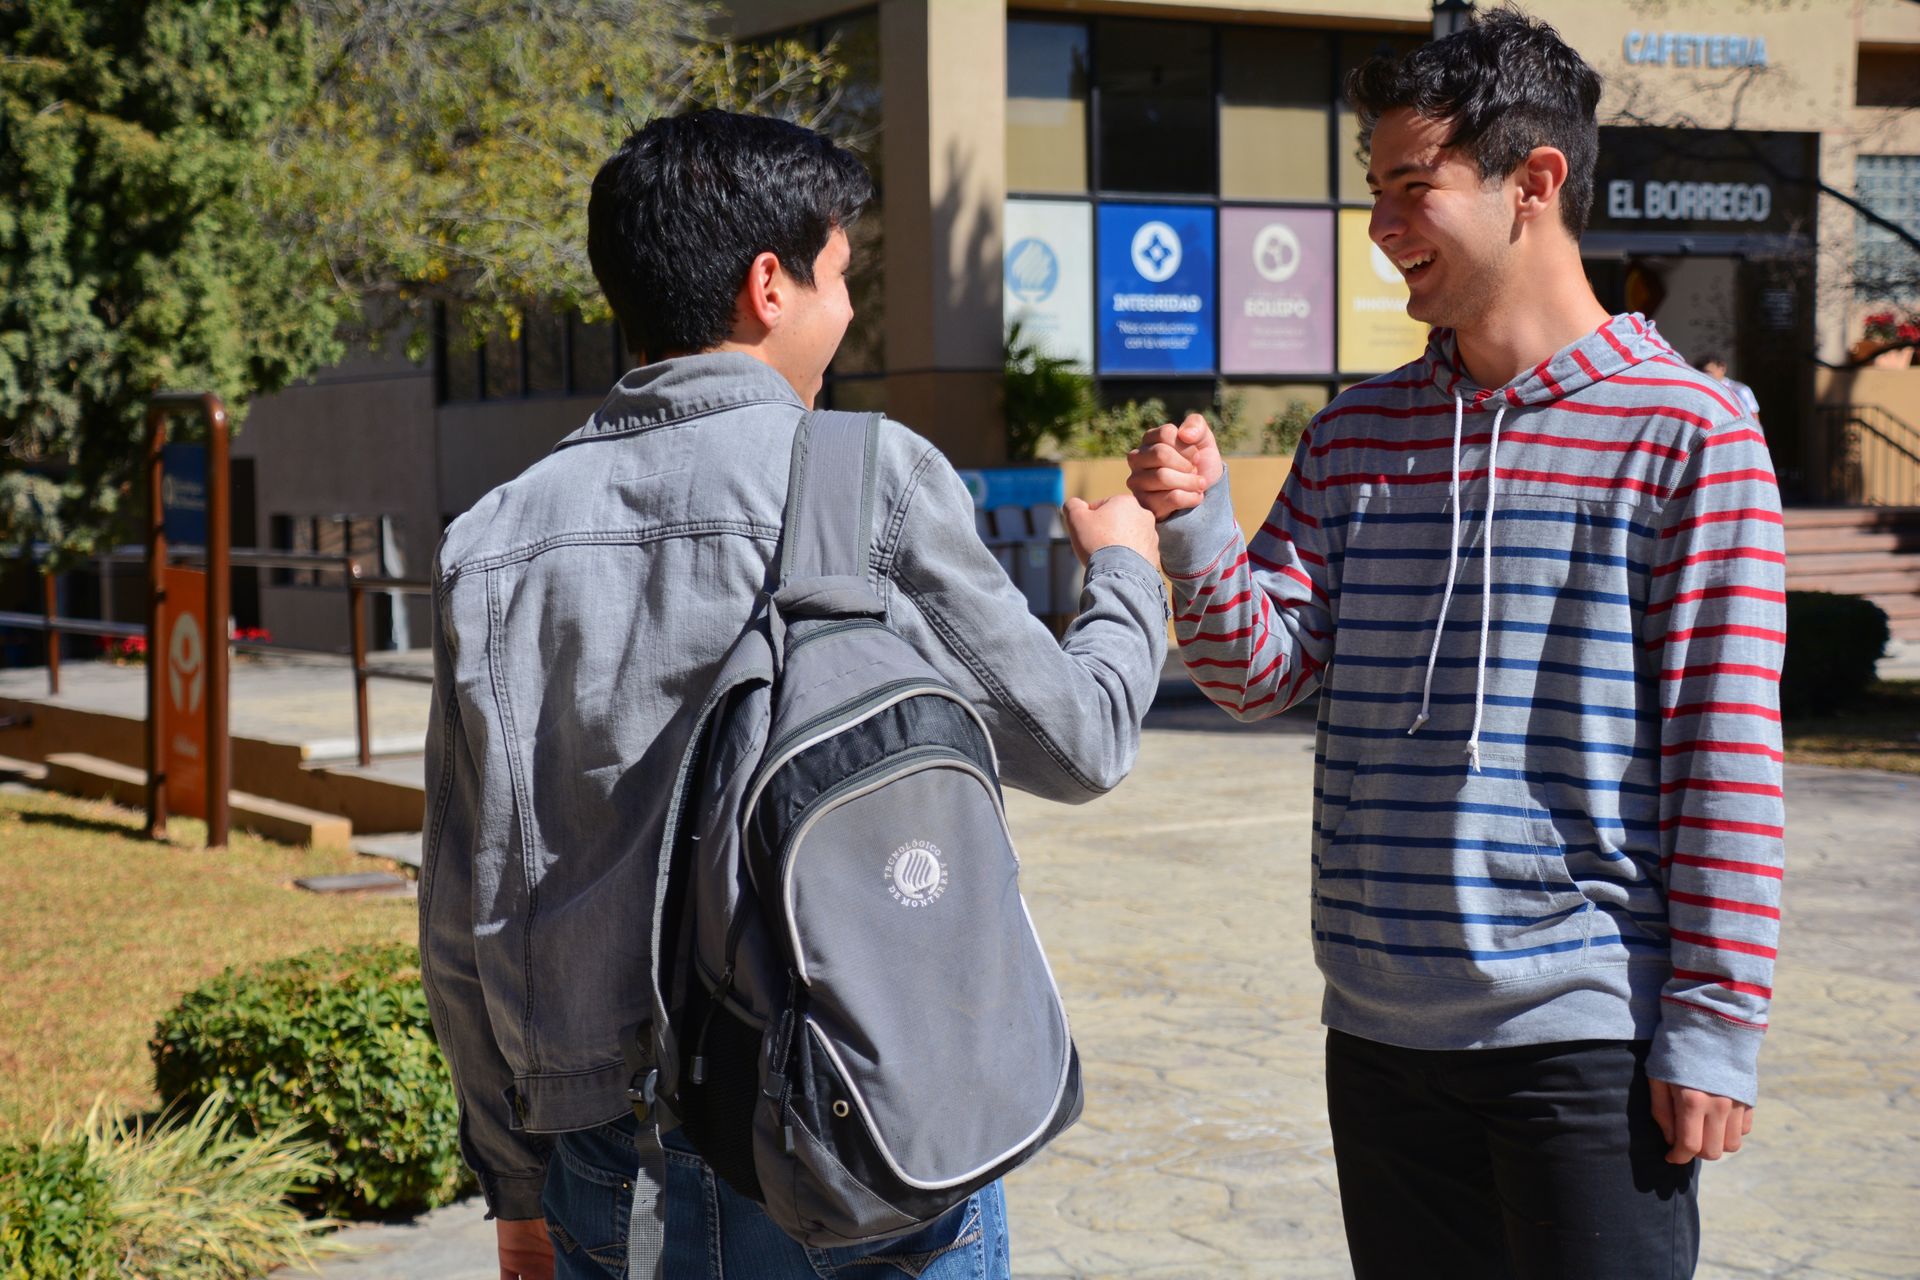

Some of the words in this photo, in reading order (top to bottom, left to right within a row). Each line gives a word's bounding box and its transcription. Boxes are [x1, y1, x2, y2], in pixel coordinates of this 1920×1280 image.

[1624, 30, 1767, 66] CAFETERIA
[1608, 180, 1641, 218] EL
[1645, 182, 1771, 221] BORREGO
[1113, 293, 1202, 312] INTEGRIDAD
[1244, 298, 1310, 318] EQUIPO
[889, 885, 901, 900] DE
